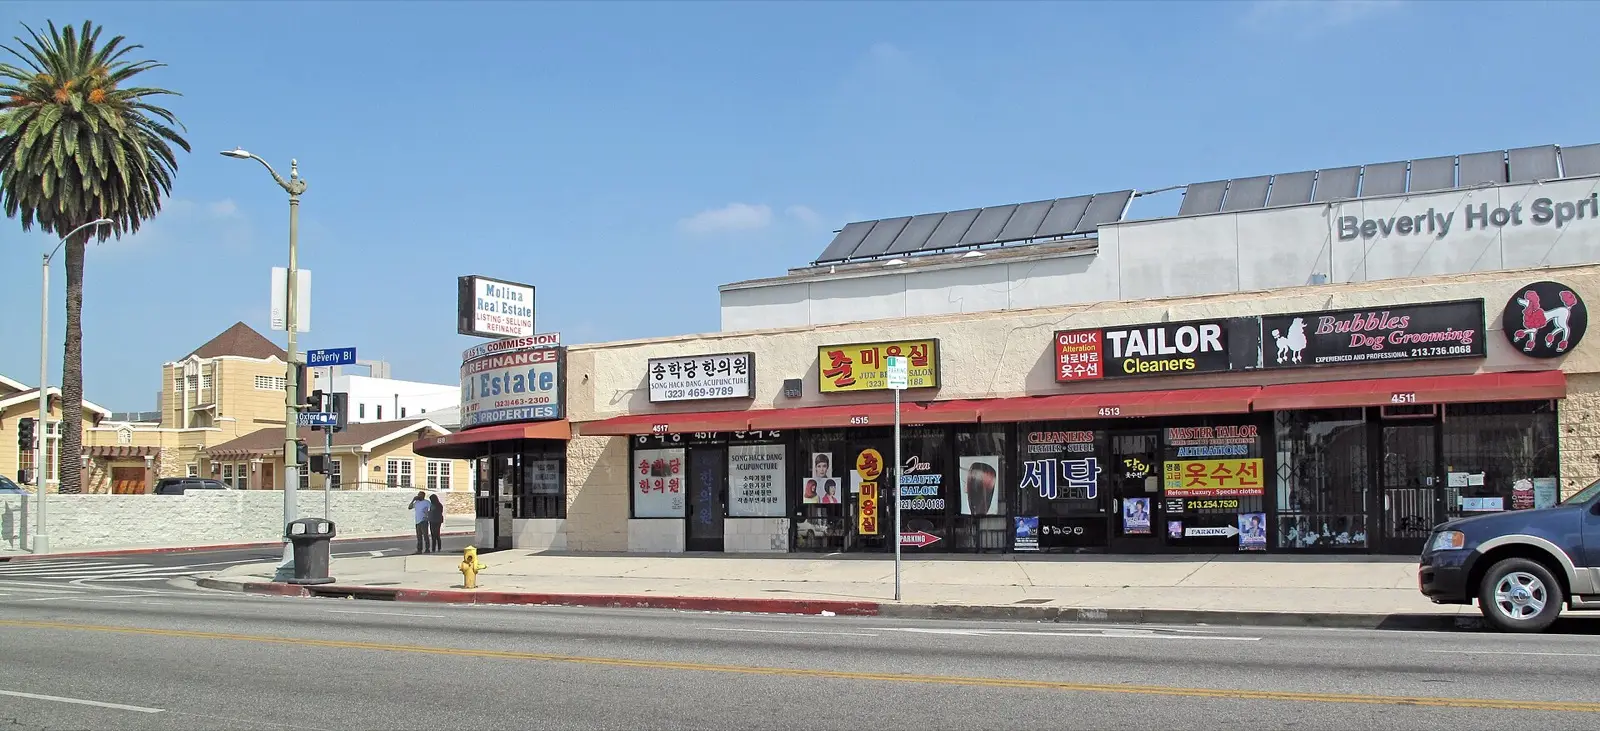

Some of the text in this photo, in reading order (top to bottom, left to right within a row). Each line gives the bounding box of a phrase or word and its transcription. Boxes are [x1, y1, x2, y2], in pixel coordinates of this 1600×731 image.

[1338, 192, 1598, 241] Beverly Hot Spri
[486, 284, 523, 302] Molina
[477, 298, 532, 317] Real Estate
[477, 313, 531, 328] LISTING SELLING
[487, 323, 522, 334] REFINANCE
[1315, 311, 1410, 335] Bubbles
[487, 335, 556, 352] COMMISSION
[1060, 332, 1097, 345] QUICK
[1106, 324, 1223, 358] TAILOR
[1348, 328, 1474, 350] Dog Grooming
[1062, 344, 1096, 353] Alteration
[1316, 354, 1352, 363] EXPERIENCED
[1366, 351, 1408, 360] PROFESSIONAL
[1412, 345, 1471, 357] 213.736.0068
[311, 352, 352, 363] Beverly Bl
[469, 350, 556, 372] REFINANCE
[1060, 353, 1098, 364] 바로바로
[652, 356, 746, 381] 송학당 한의원
[1061, 364, 1097, 378] 옷수선
[1123, 358, 1196, 374] Cleaners
[481, 368, 553, 398] Estate
[704, 378, 746, 386] ACUPUNCTURE
[665, 390, 685, 398] (323)
[1391, 393, 1416, 403] 4511
[482, 406, 553, 422] PROPERTIES
[1028, 431, 1094, 444] CLEANERS
[1168, 425, 1258, 440] MASTER TAILOR
[766, 453, 782, 461] DANG
[1177, 445, 1248, 457] ALTERATIONS
[1020, 457, 1102, 500] 세탁
[1185, 462, 1258, 486] 옷수선
[639, 478, 681, 494] 한의원
[901, 486, 938, 496] SALON
[861, 484, 876, 532] 미용실
[1187, 500, 1238, 508] 213.254.7520
